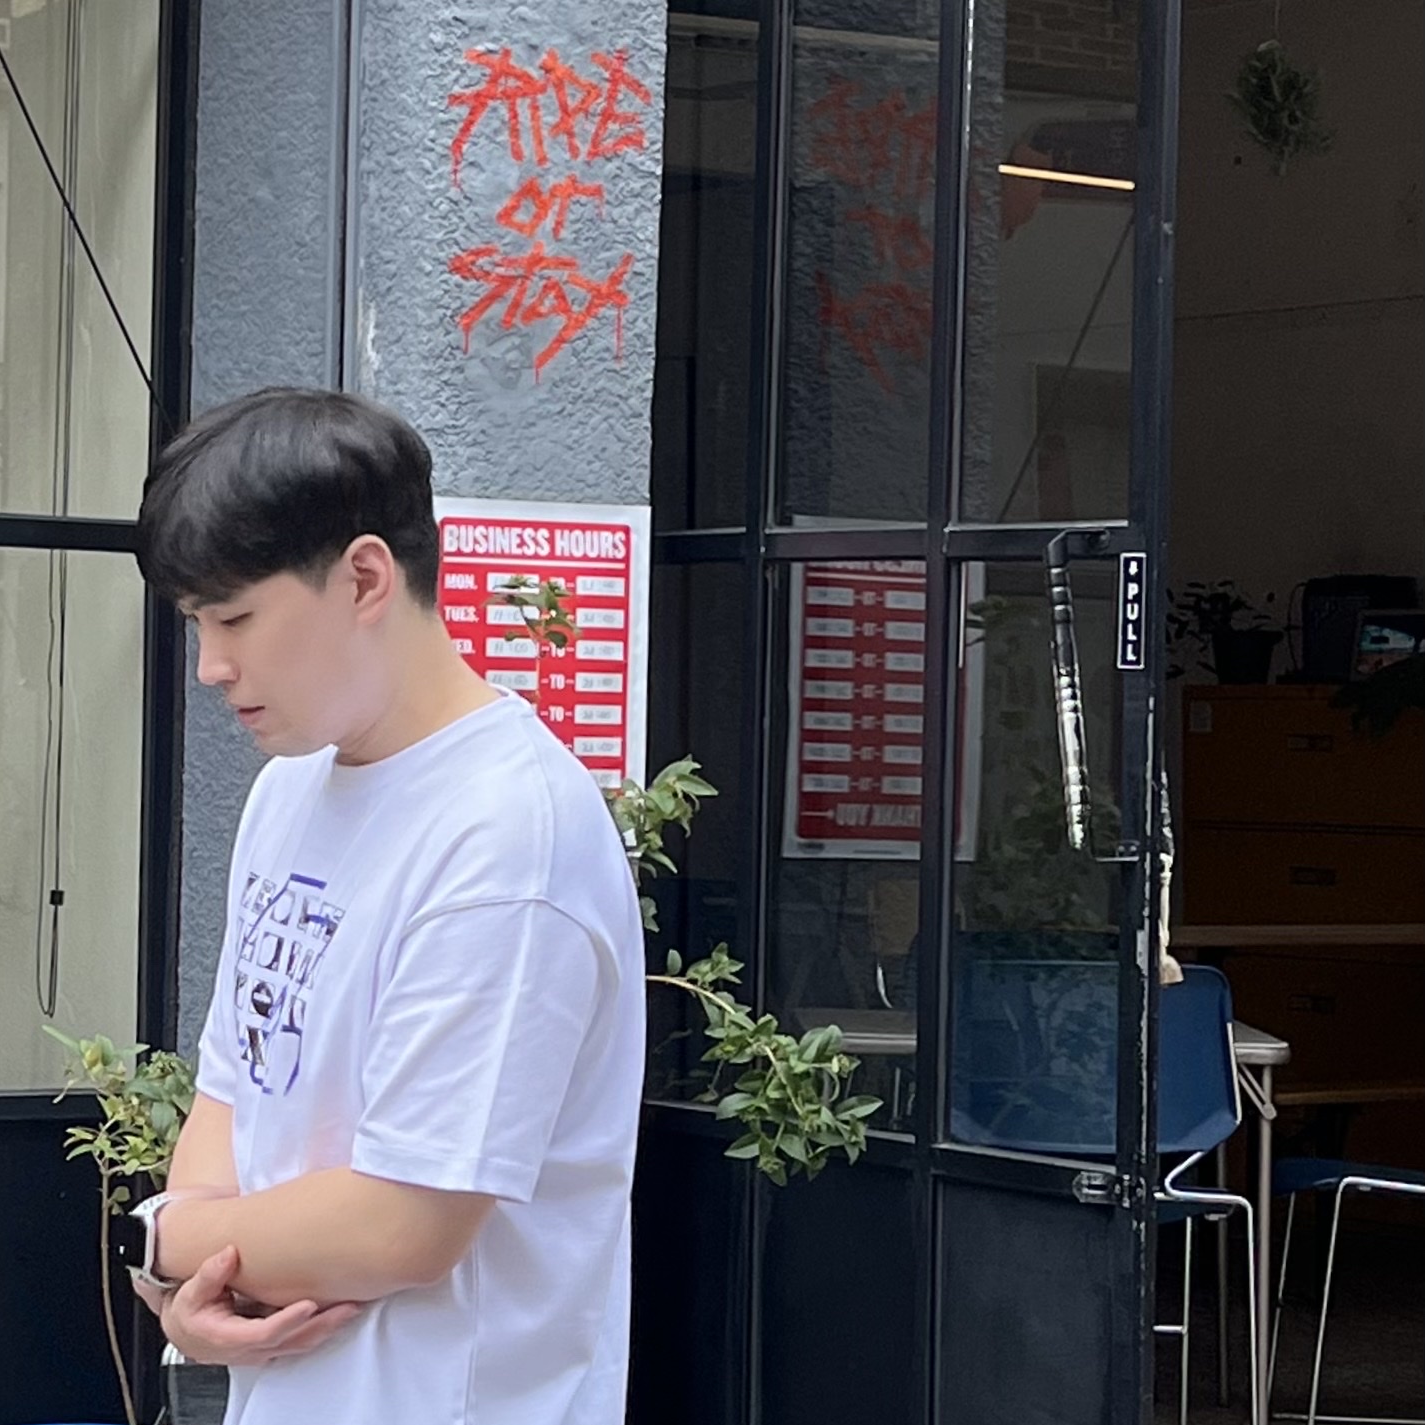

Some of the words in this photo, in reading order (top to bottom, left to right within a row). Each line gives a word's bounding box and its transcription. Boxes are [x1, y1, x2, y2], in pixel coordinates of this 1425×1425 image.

[442, 524, 551, 556] BUSINESS
[553, 528, 627, 558] HOURS
[444, 573, 478, 590] MON.
[443, 605, 479, 622] TUES.
[1125, 582, 1141, 662] PULL
[549, 673, 566, 690] TO
[548, 705, 565, 723] TO
